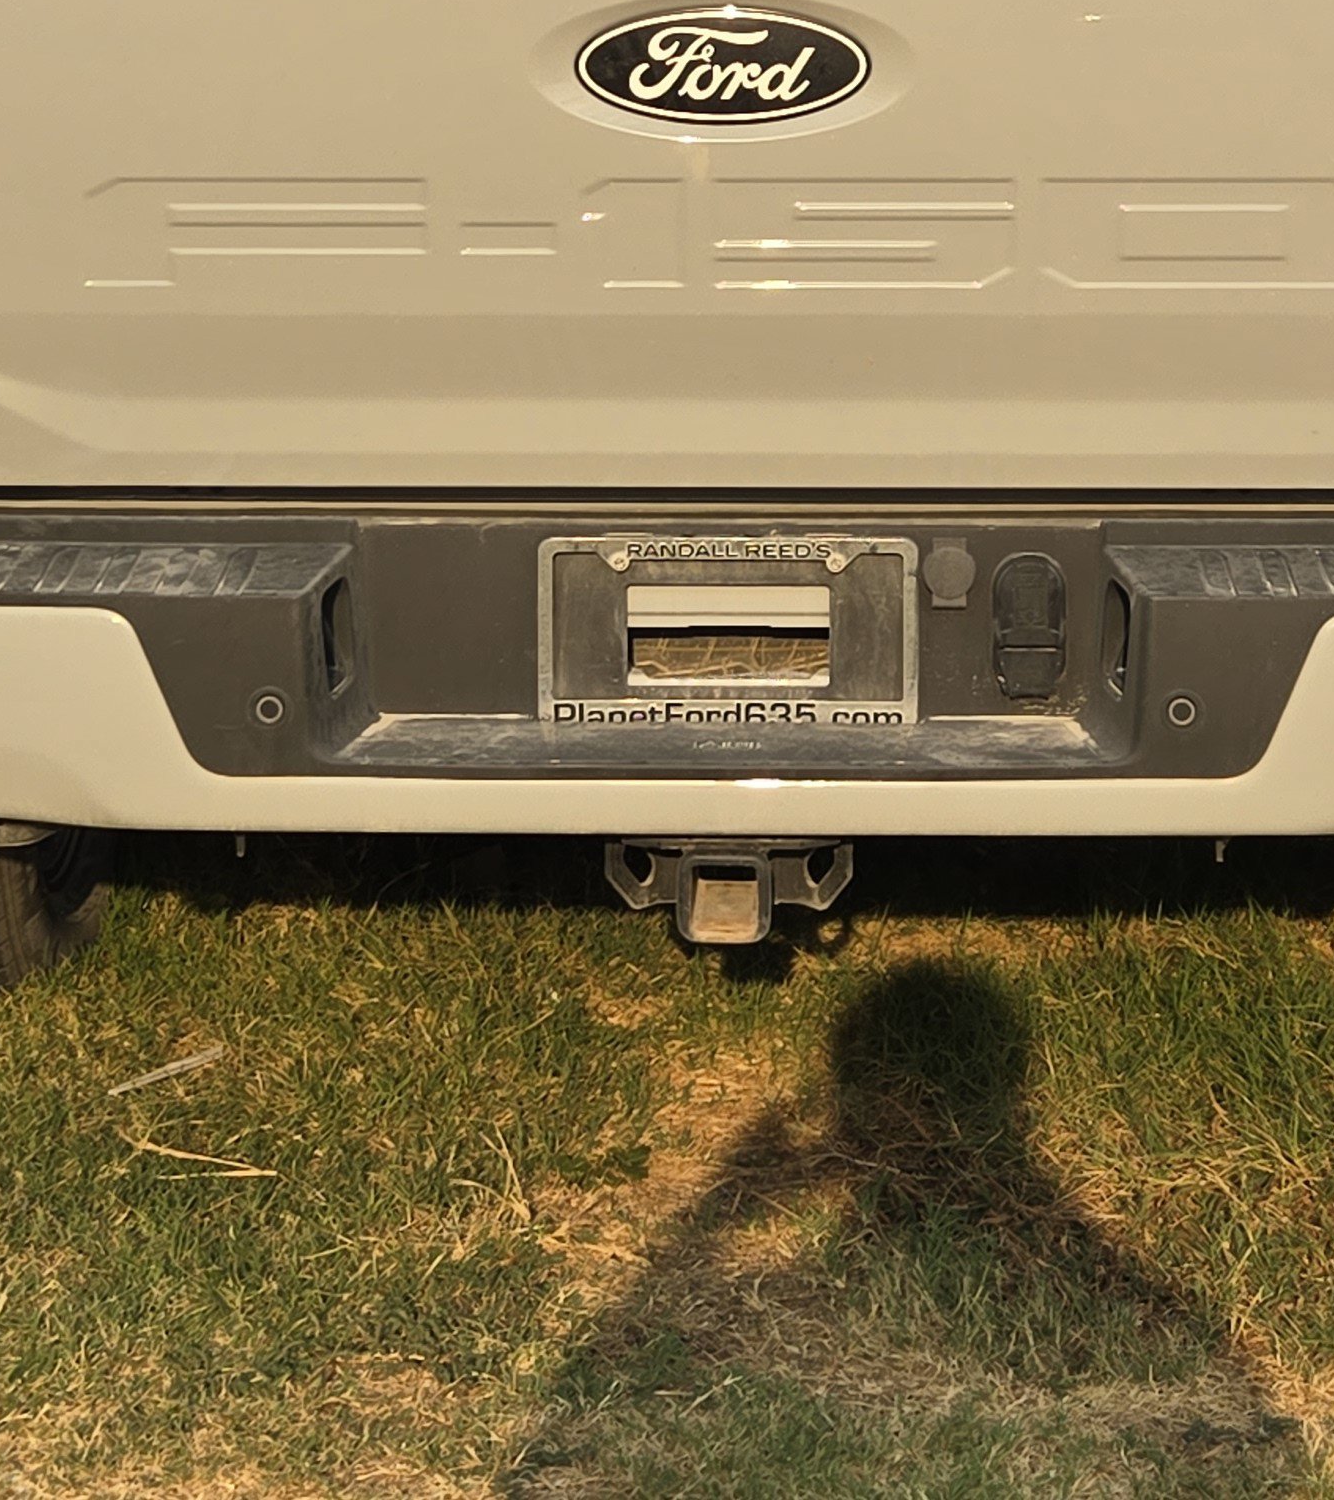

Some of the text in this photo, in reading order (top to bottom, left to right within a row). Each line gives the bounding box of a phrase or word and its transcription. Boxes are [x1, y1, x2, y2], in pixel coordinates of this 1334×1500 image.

[629, 26, 815, 100] Ford
[627, 542, 831, 558] RANDALL REED'S
[553, 703, 903, 723] PlanetFord635com
